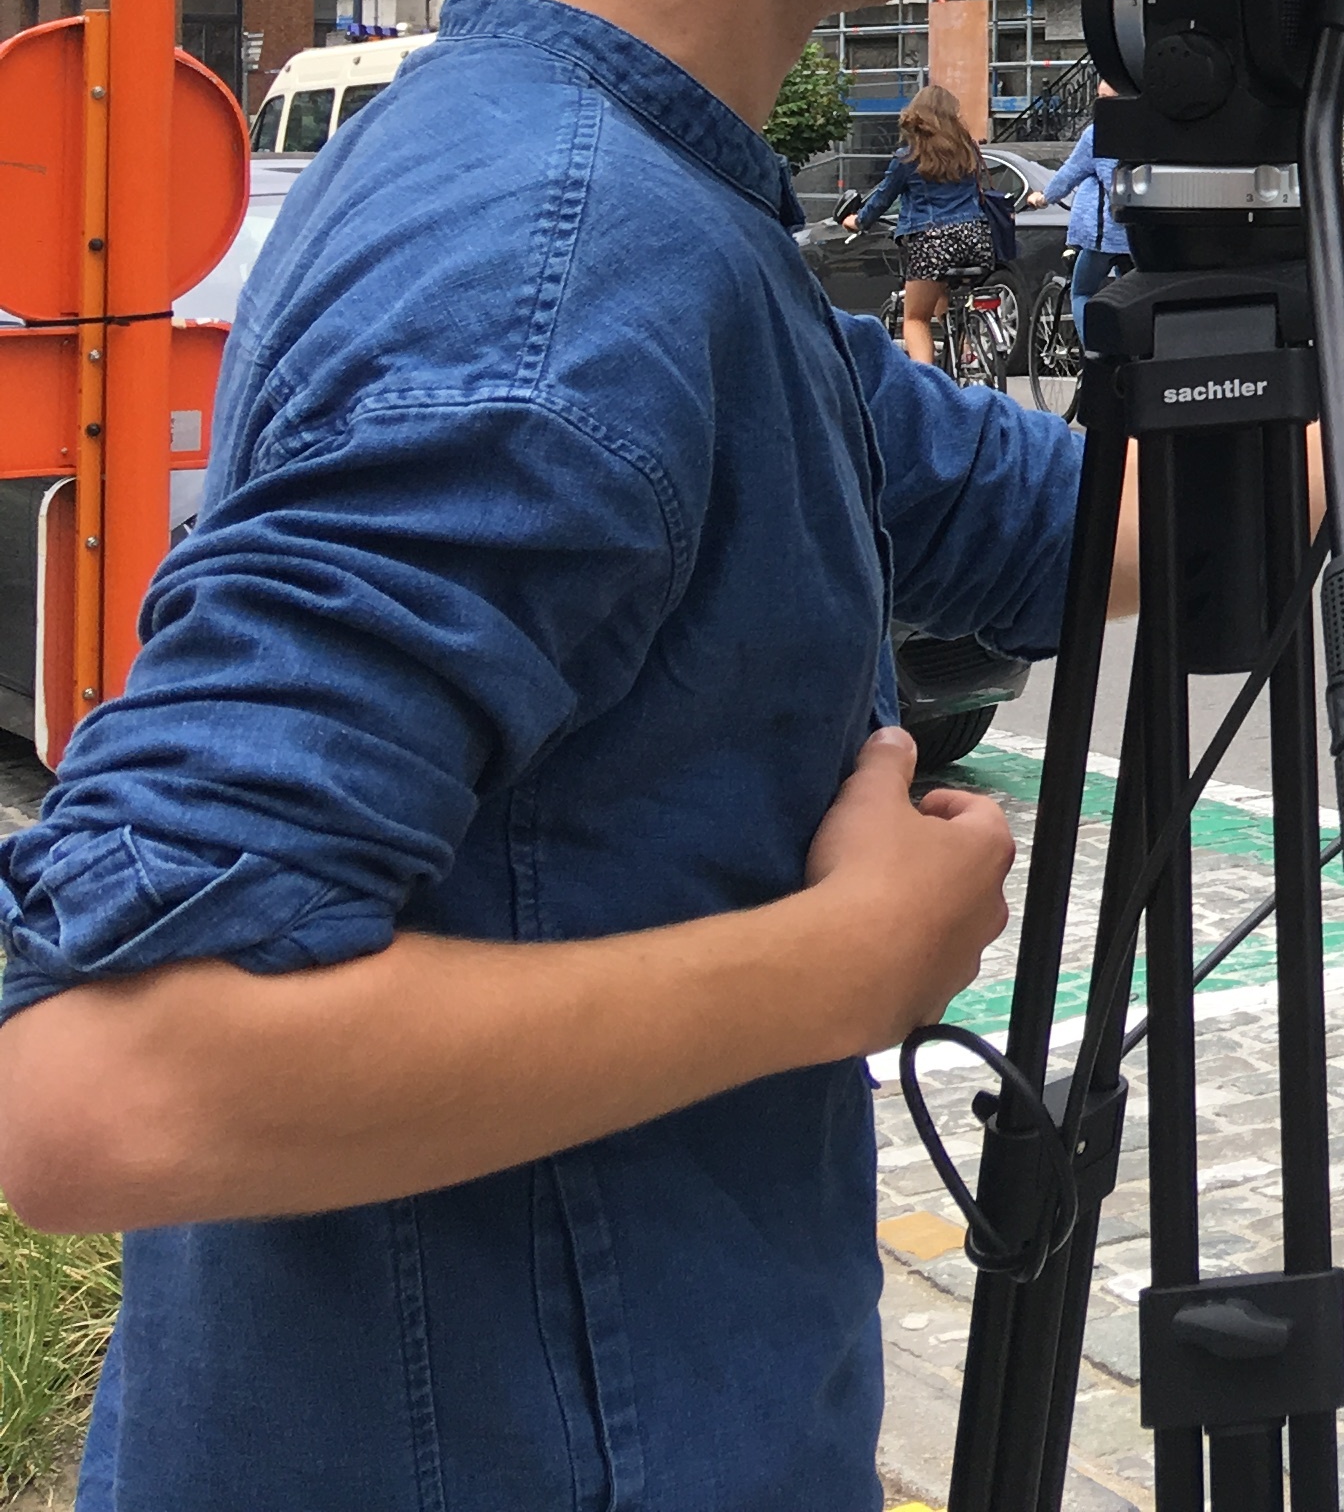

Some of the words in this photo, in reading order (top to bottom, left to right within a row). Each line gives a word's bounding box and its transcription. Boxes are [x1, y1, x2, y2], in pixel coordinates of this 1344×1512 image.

[1246, 193, 1254, 203] 3
[1282, 193, 1289, 203] 2
[1163, 378, 1268, 404] sachtler
